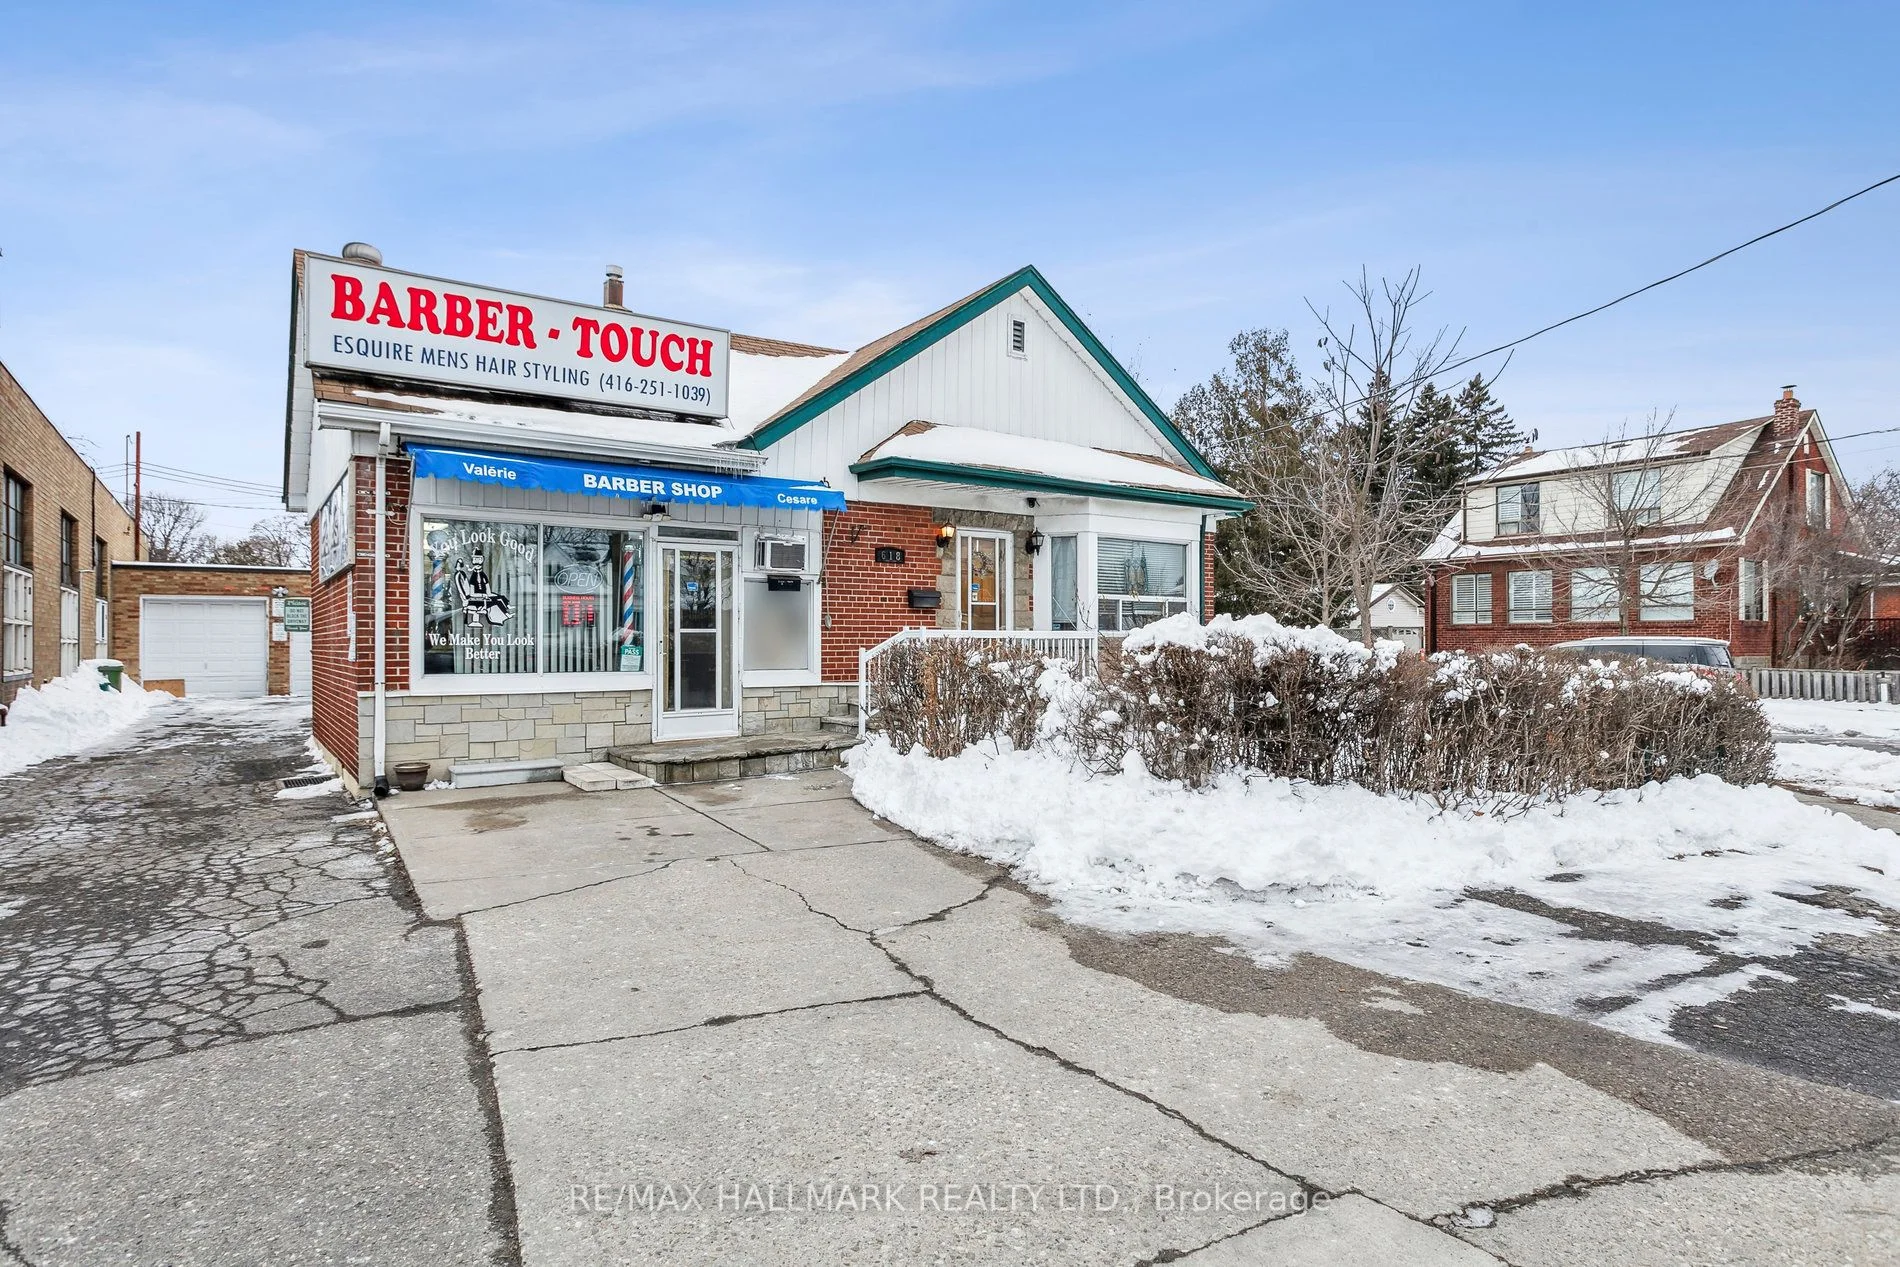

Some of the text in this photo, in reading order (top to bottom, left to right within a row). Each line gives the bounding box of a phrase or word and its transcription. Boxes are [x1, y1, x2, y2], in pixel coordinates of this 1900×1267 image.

[331, 274, 537, 349] BARBER
[572, 316, 714, 377] TOUCH
[333, 335, 711, 406] ESQUIRE MENS HAIR STYLING (416-251-1039)
[462, 462, 517, 480] Valérie
[583, 473, 723, 499] BARBER SHOP
[777, 493, 818, 505] Cesare
[460, 527, 496, 546] Look
[499, 530, 535, 563] Good
[881, 550, 901, 561] 618
[557, 571, 598, 587] OPEN
[428, 633, 535, 646] We Make You Look
[465, 647, 501, 660] Better
